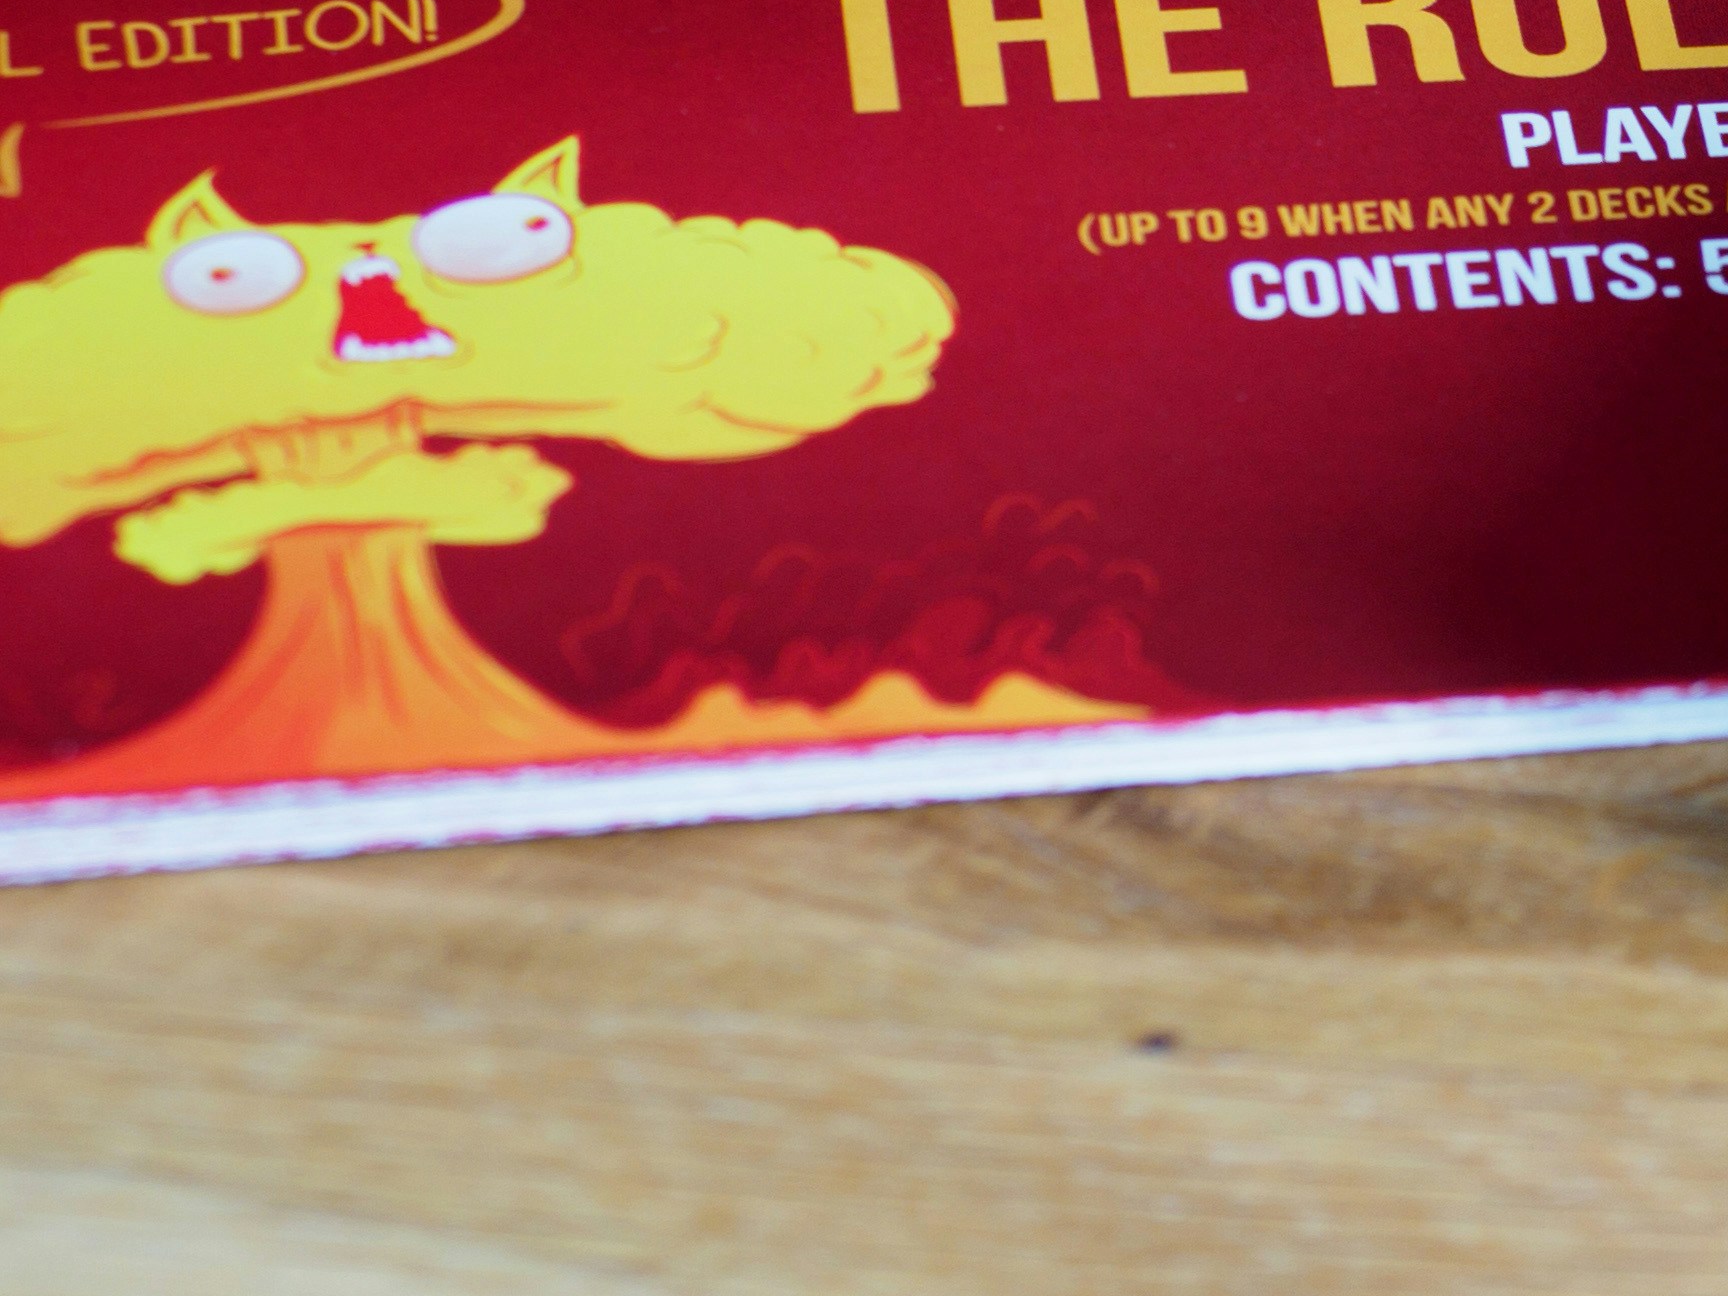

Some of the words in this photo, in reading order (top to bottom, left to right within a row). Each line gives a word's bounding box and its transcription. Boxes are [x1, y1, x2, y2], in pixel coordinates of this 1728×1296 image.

[1077, 211, 1160, 255] (UP
[1167, 209, 1228, 243] TO
[1236, 205, 1269, 240] 9
[1276, 198, 1414, 238] WHEN
[1426, 193, 1514, 230] ANY
[1527, 191, 1558, 224] 2
[1567, 183, 1713, 222] DECKS
[1230, 242, 1682, 321] CONTENTS:
